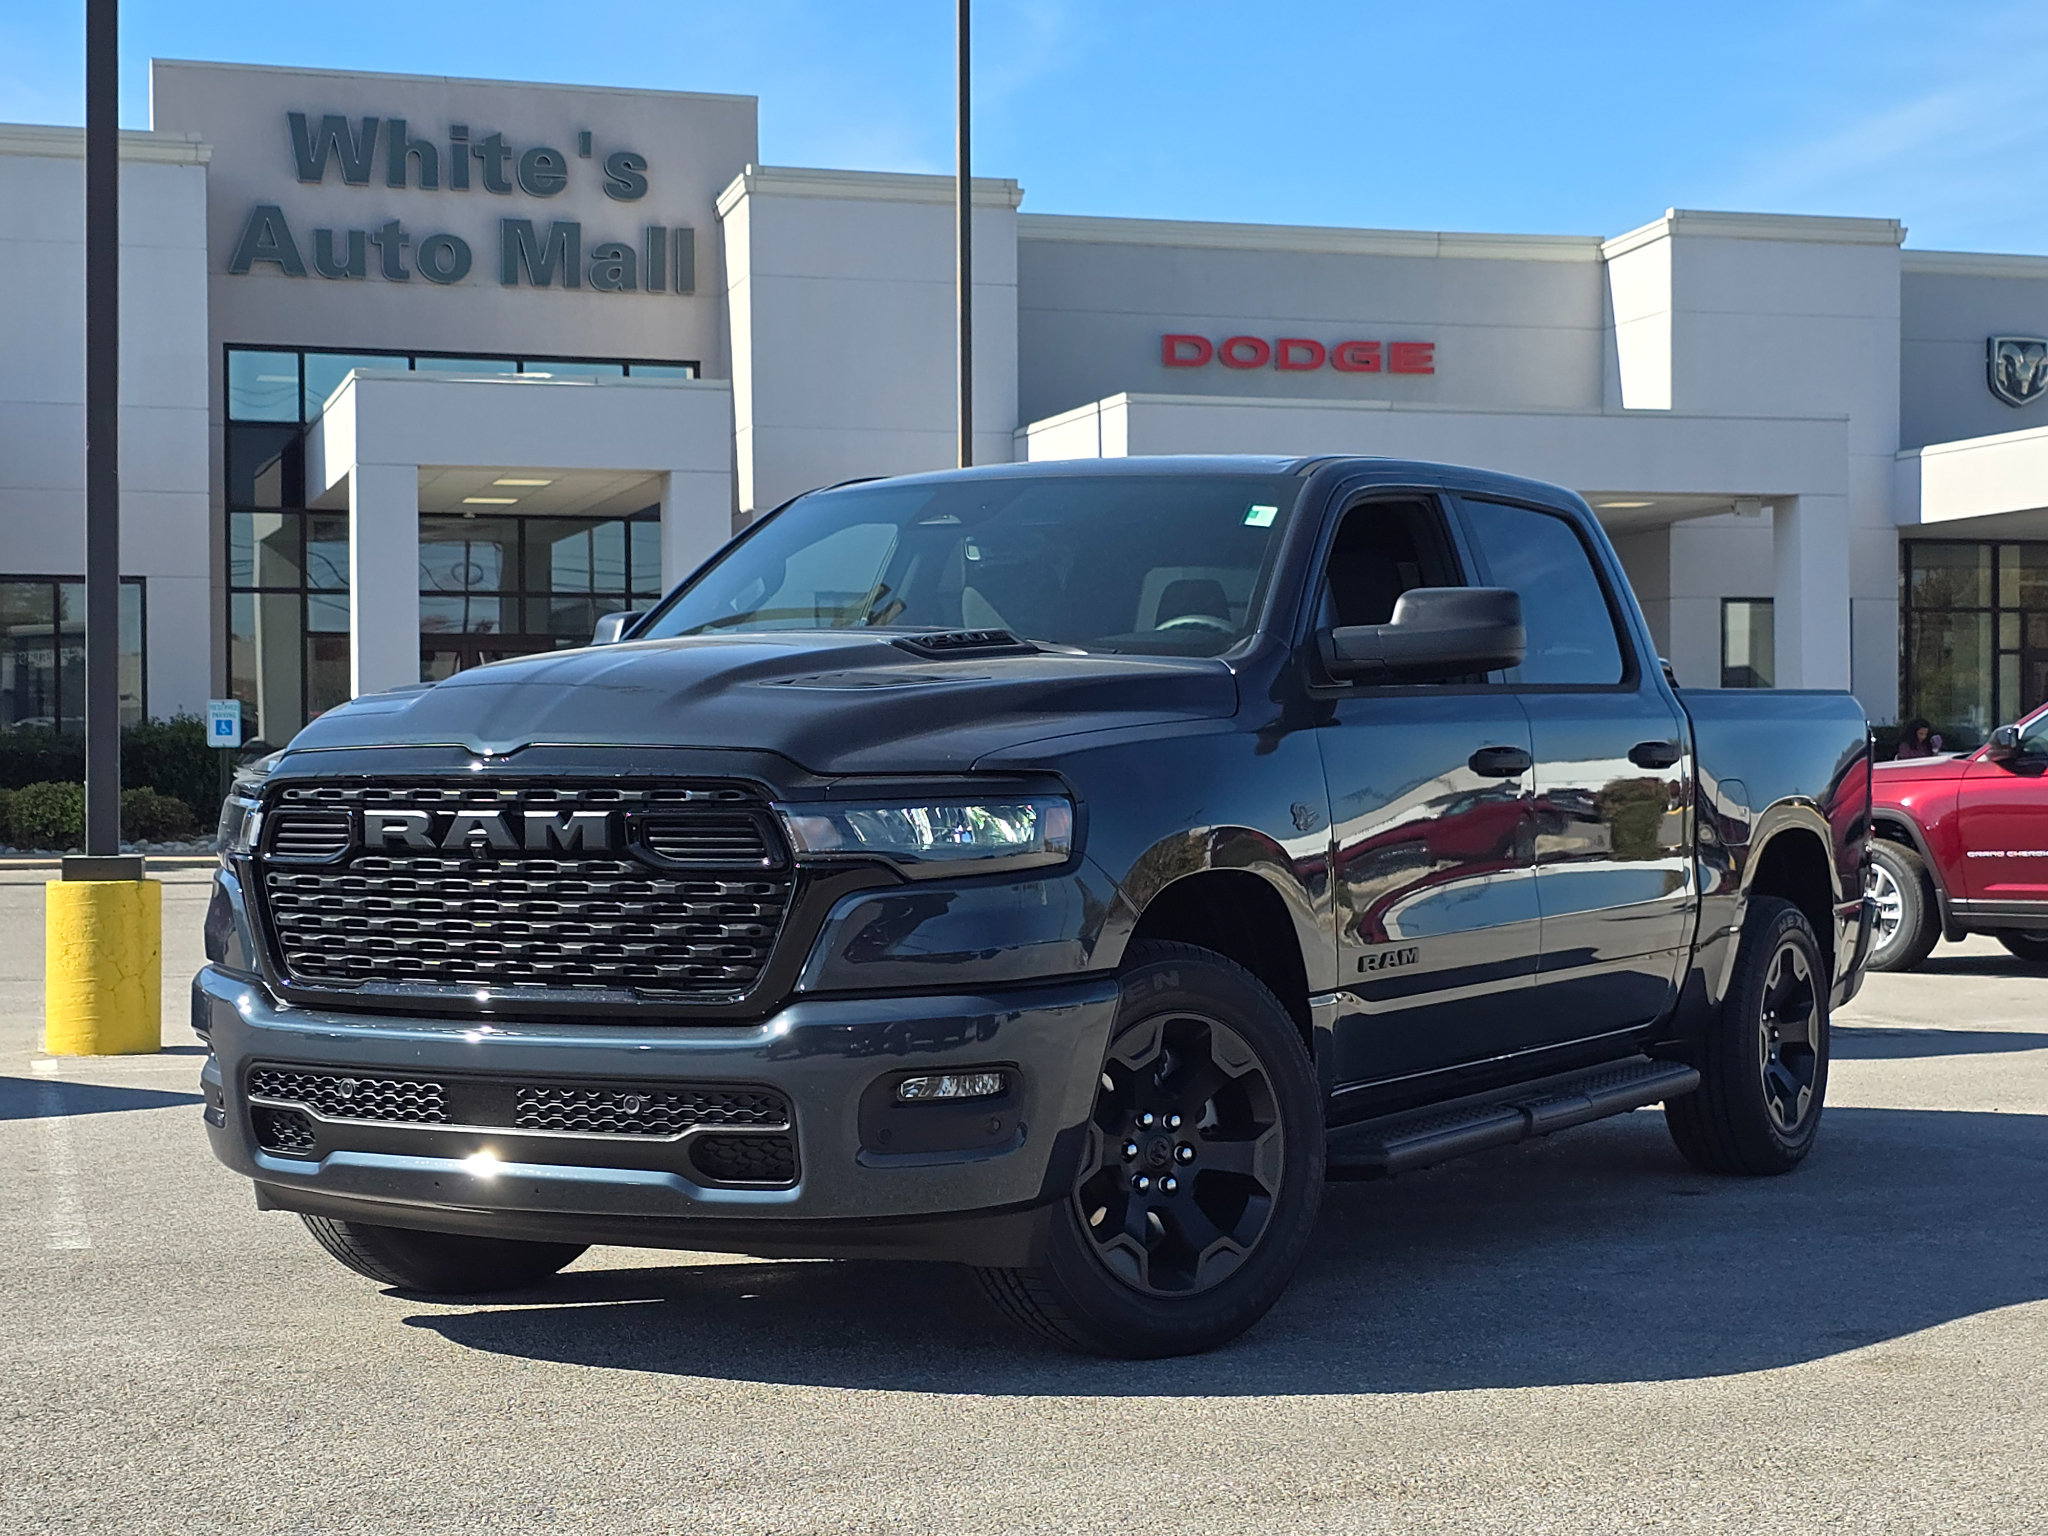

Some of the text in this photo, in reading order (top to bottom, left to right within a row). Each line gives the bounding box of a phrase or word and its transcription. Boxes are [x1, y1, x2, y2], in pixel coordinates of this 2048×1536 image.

[287, 112, 649, 201] White's
[229, 205, 696, 294] Auto Mall
[1162, 334, 1436, 375] DODGE
[363, 809, 617, 850] RAM
[1358, 946, 1419, 974] RAM
